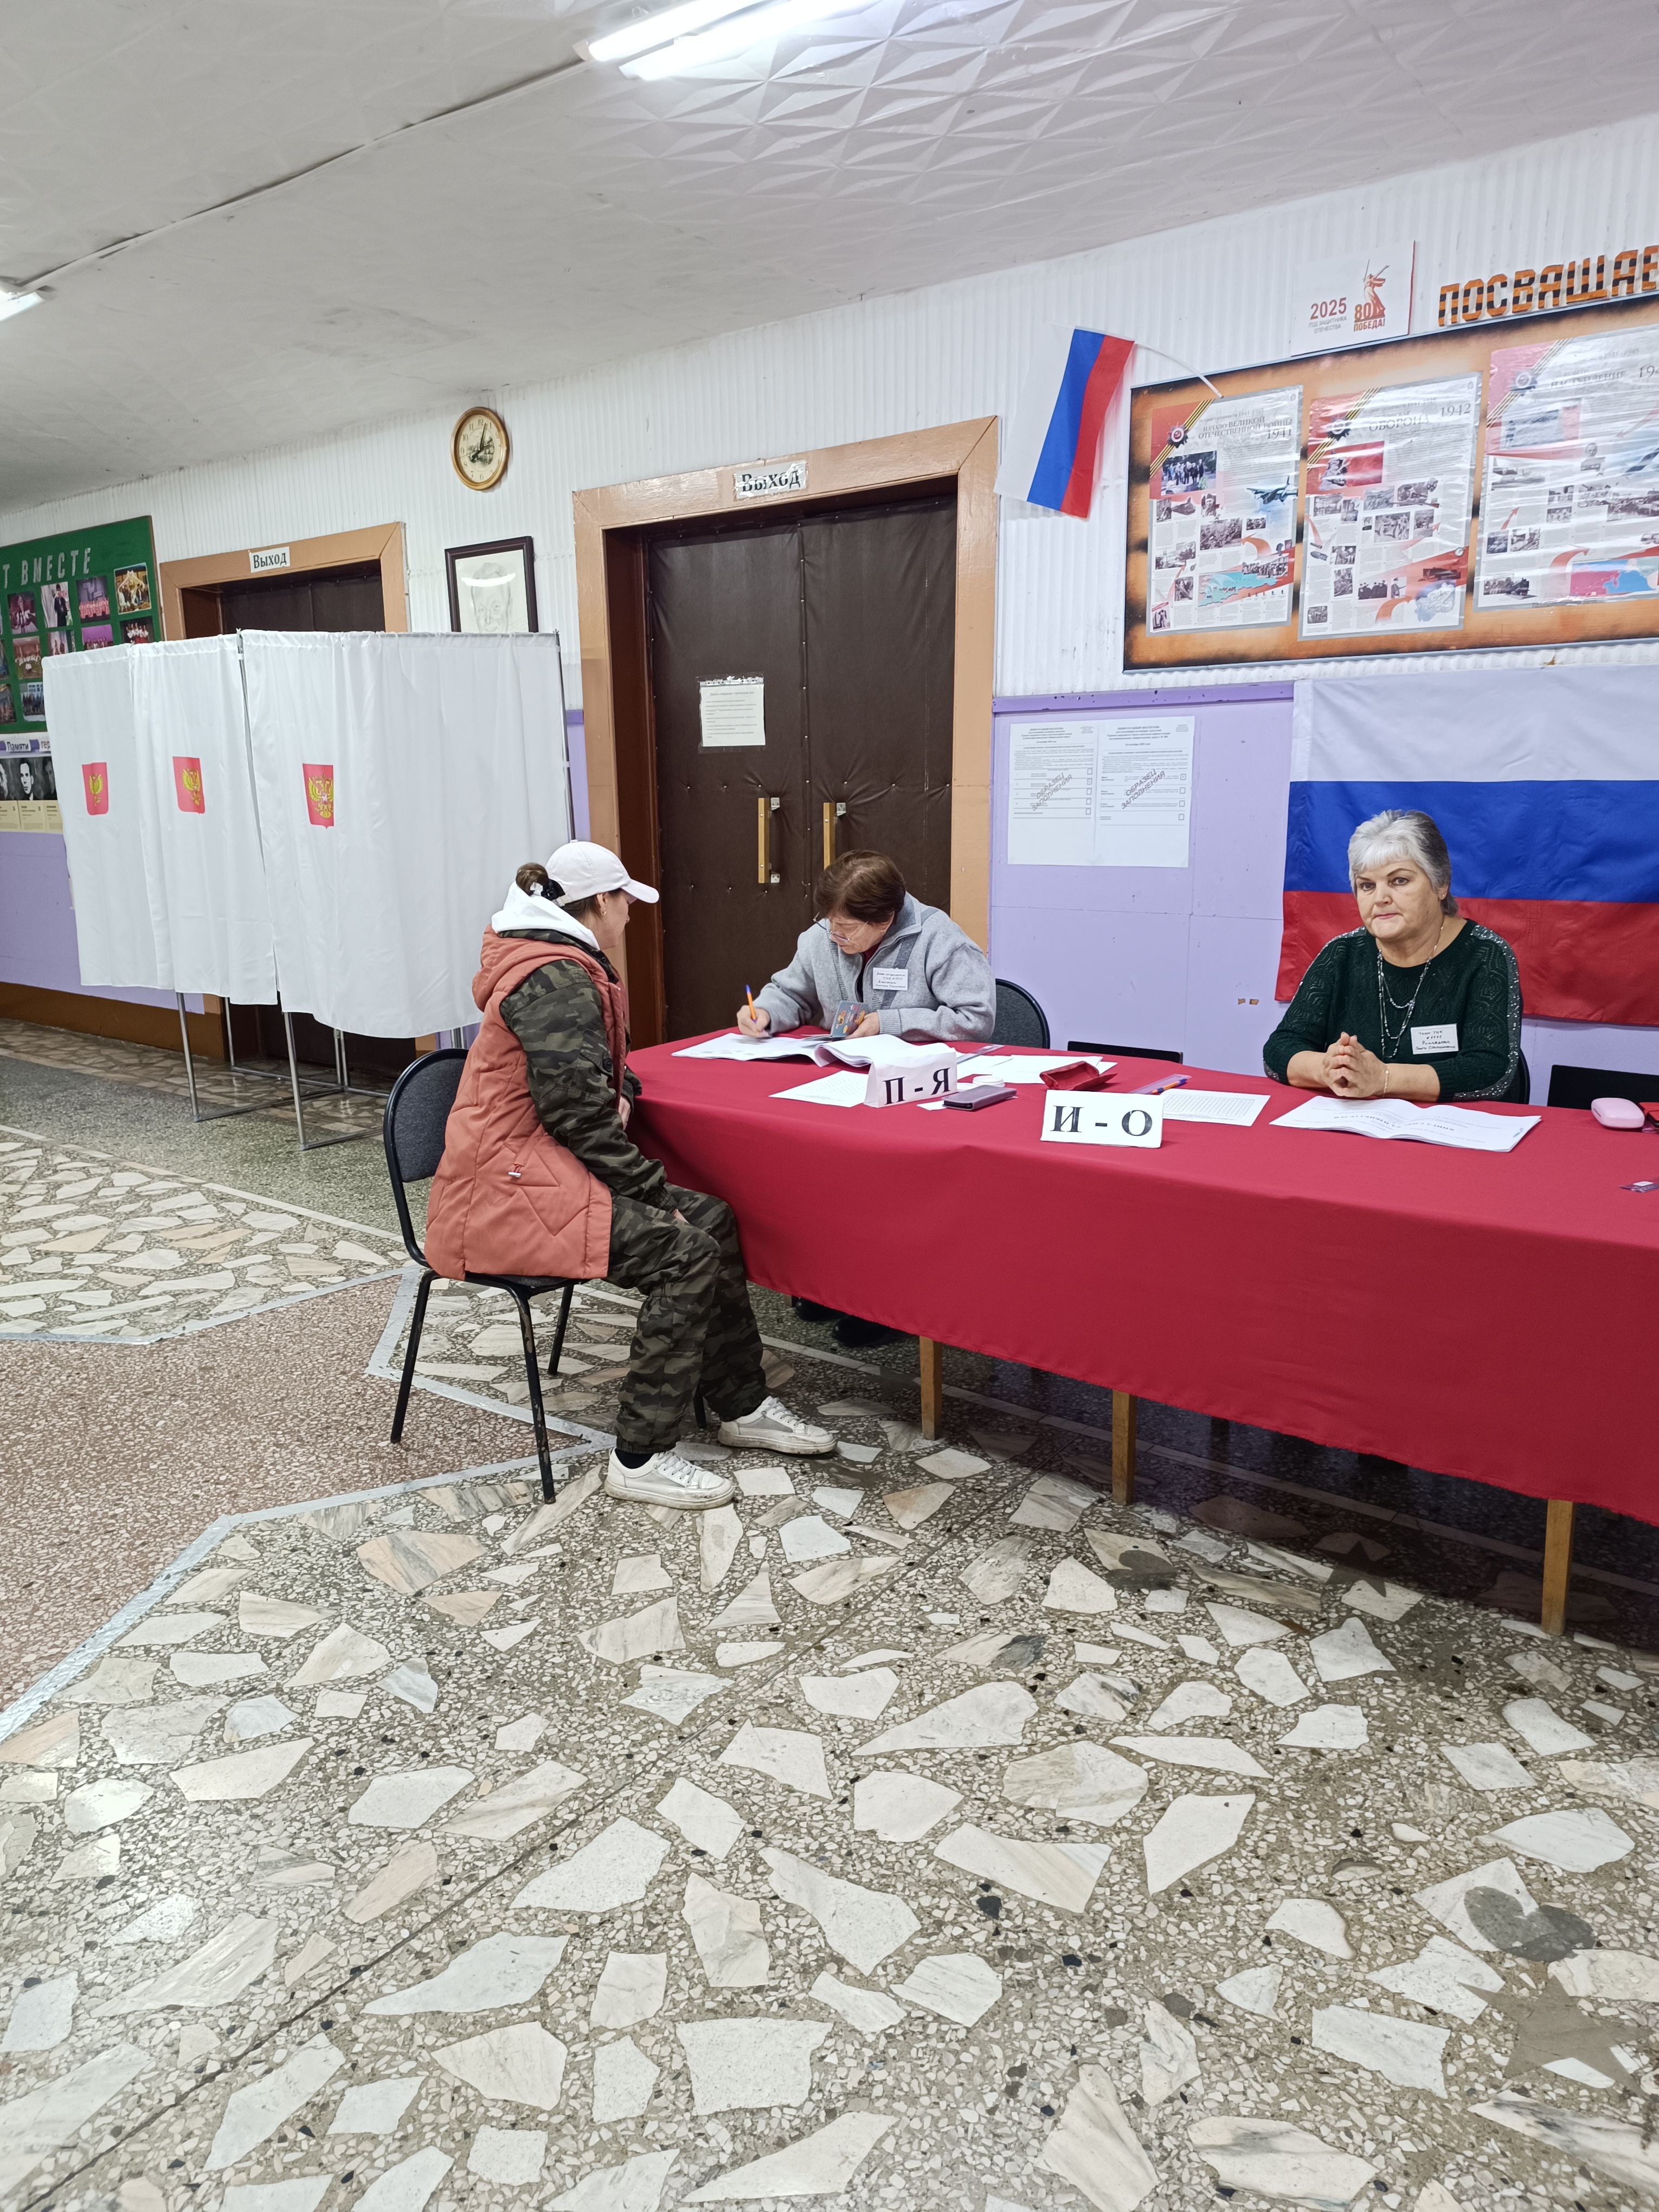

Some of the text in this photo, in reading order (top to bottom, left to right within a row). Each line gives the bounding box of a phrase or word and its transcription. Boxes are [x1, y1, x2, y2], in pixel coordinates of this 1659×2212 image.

[1438, 245, 1659, 327] ПОСВЯЩАЕ
[1310, 297, 1347, 320] 2025
[1354, 303, 1372, 320] 80
[1314, 324, 1342, 333] ОТЕЧЕСТВА
[1319, 316, 1347, 326] ЗАЩИТНИКА
[1353, 318, 1386, 332] ПОБЕДА!
[1440, 403, 1471, 417] 1942
[1198, 419, 1293, 440] ОТЕЧЕСТВЕННОЙ ВОЙНЫ
[1203, 423, 1227, 432] НАЧАЛО
[1229, 416, 1265, 428] ВЕЛИКОЙ
[1267, 428, 1292, 440] 1941
[742, 470, 801, 492] Выход
[21, 548, 91, 586] ВМЕСТЕ
[253, 552, 287, 569] Выход
[1032, 774, 1072, 811] ЗАПОЛНЕНИЯ
[1037, 772, 1065, 799] ОБРАЗЕЦ
[1121, 770, 1166, 809] ЗАПОЛНЕНИЯ
[1126, 768, 1156, 796] ОБРАЗЕЦ
[882, 1077, 906, 1105] П
[930, 1067, 951, 1096] Я
[1050, 1105, 1084, 1133] И
[1121, 1109, 1153, 1136] О
